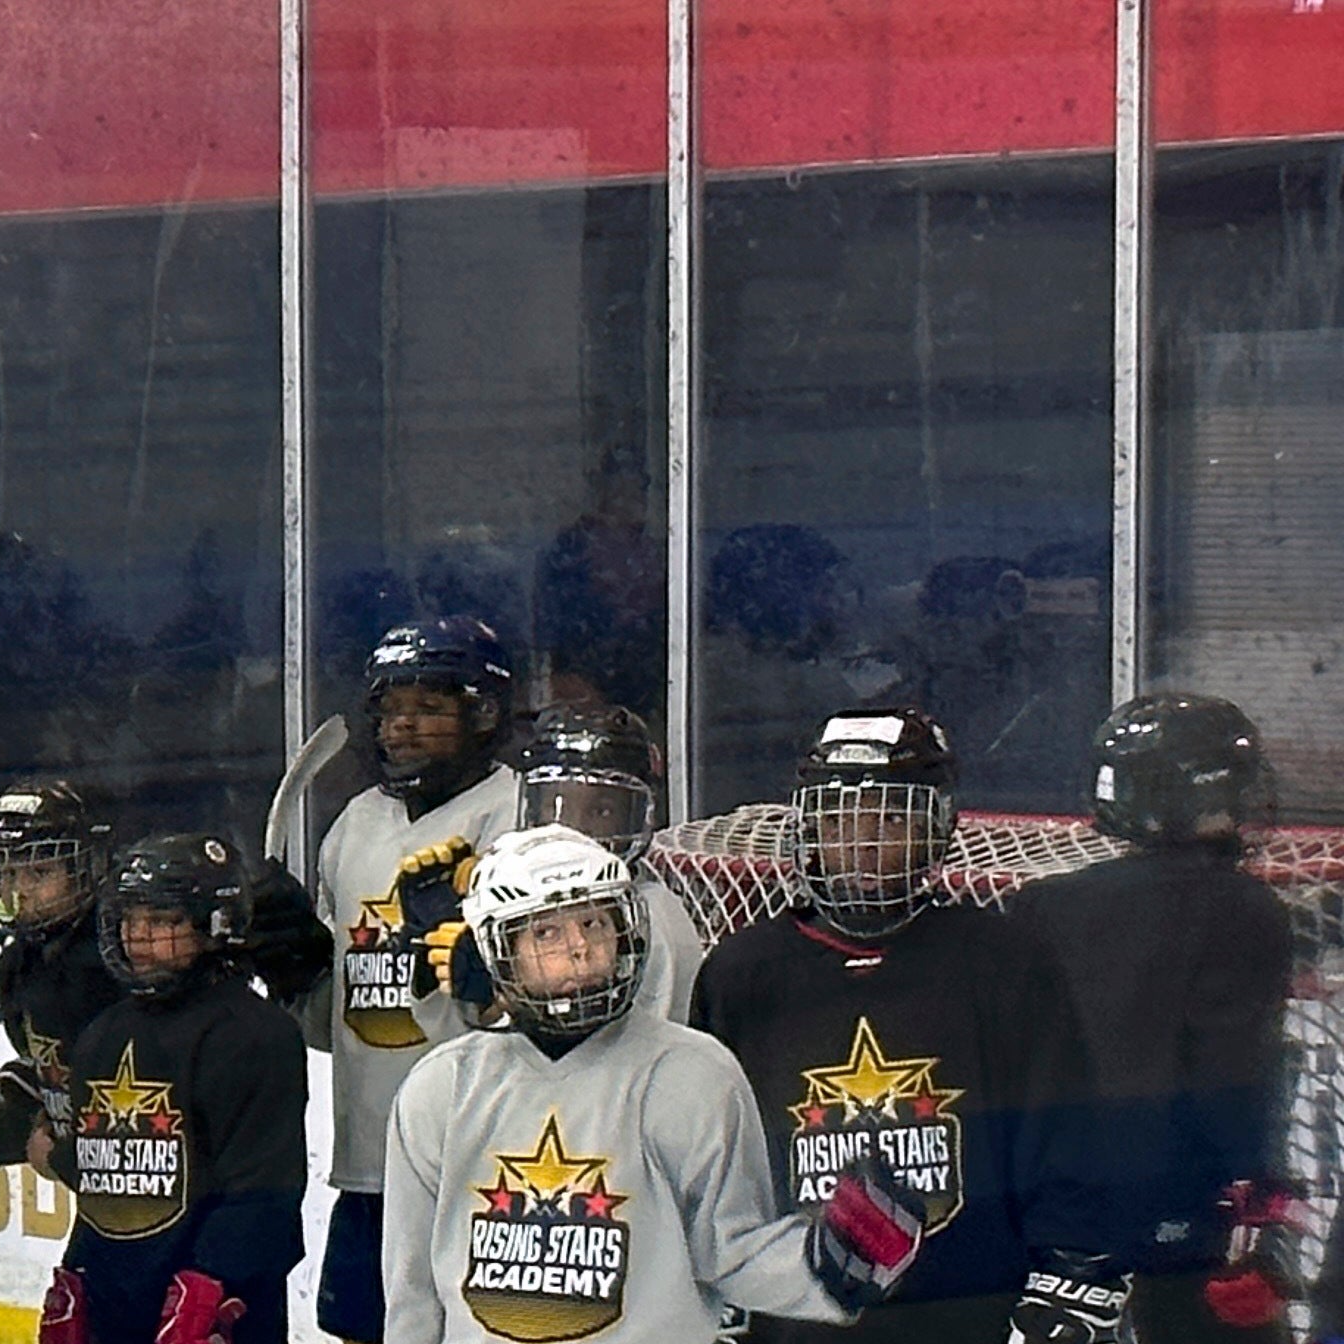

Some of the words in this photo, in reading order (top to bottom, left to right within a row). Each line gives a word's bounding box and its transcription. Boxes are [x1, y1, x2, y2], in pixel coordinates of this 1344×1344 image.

[349, 986, 412, 1009] ACADE
[77, 1137, 121, 1171] RISING
[124, 1138, 179, 1173] STARS
[797, 1131, 871, 1176] RISING
[879, 1125, 949, 1170] STARS
[79, 1172, 177, 1197] ACADEMY
[798, 1164, 947, 1202] ACMY
[473, 1219, 543, 1262] RISING
[544, 1223, 623, 1270] STARS
[468, 1261, 617, 1299] ACADEMY
